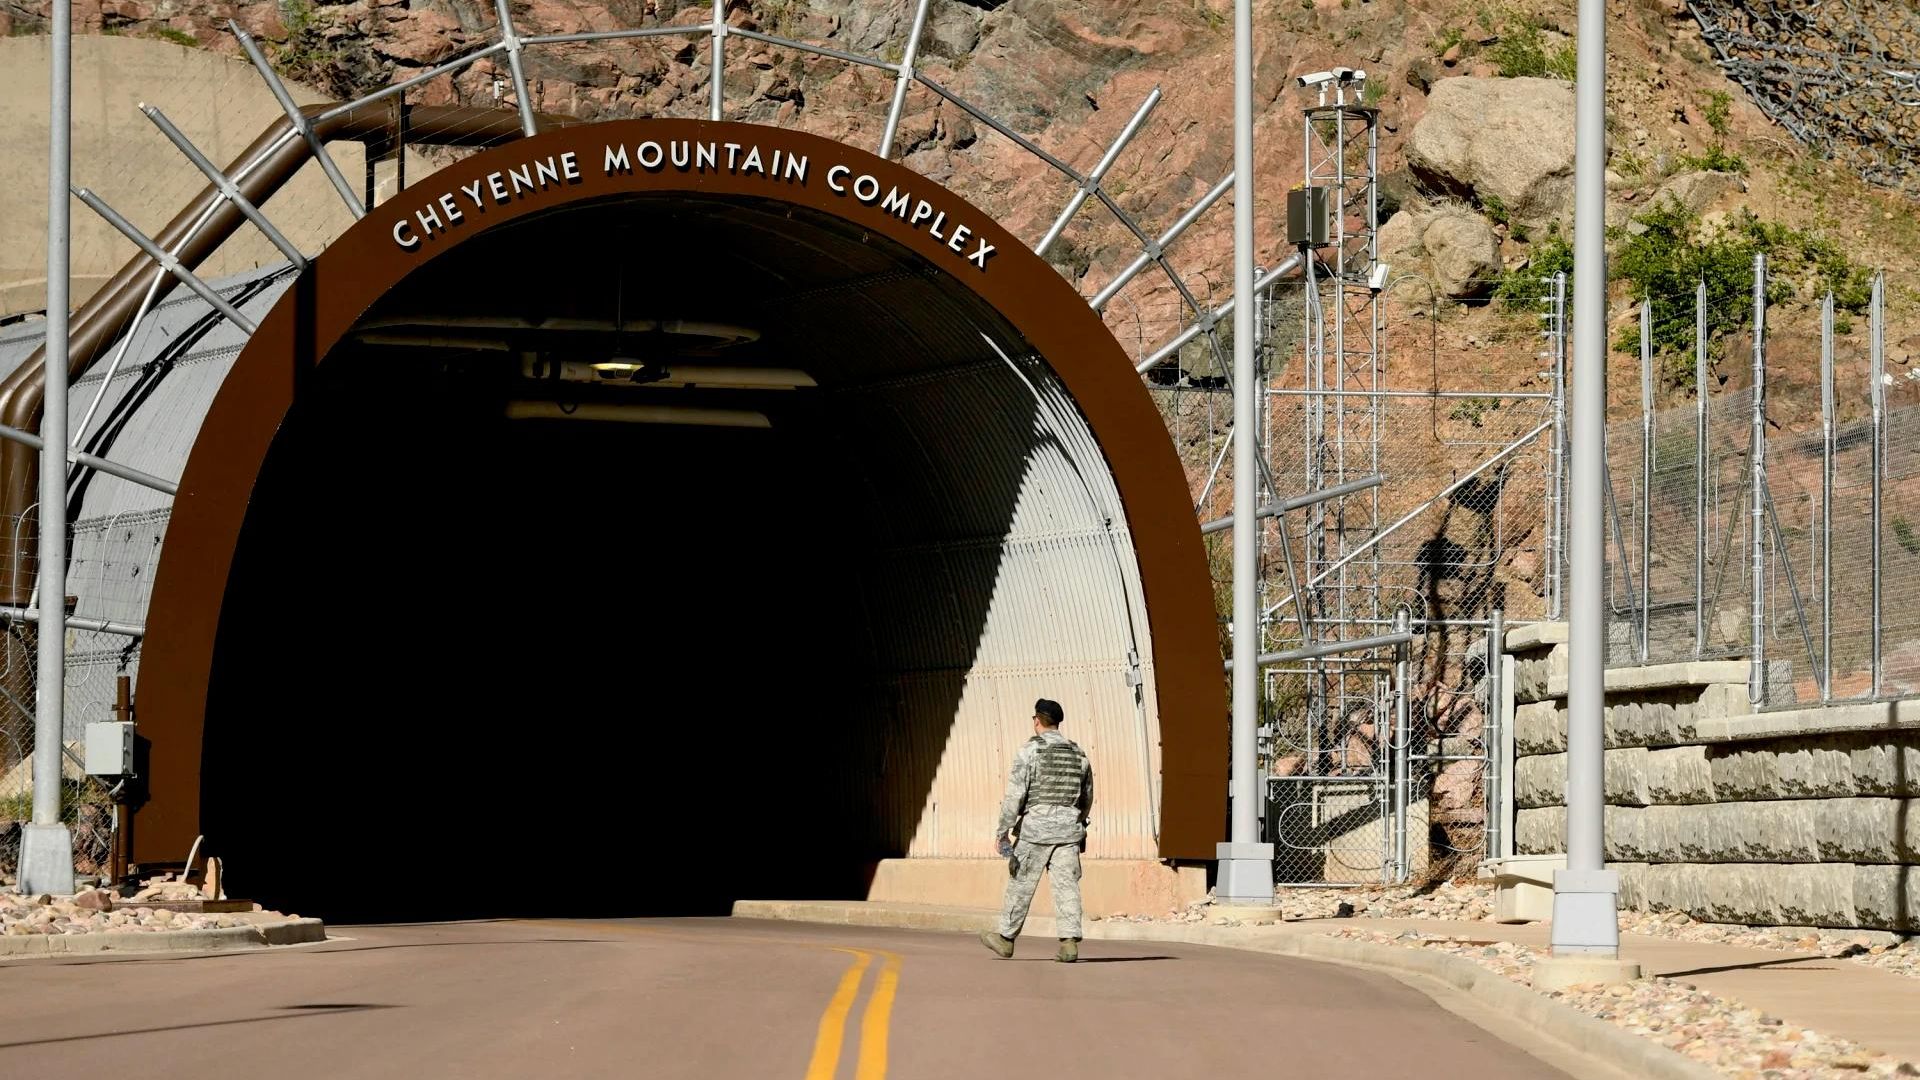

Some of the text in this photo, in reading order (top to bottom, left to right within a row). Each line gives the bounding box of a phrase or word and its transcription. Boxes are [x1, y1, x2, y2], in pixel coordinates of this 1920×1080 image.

[393, 140, 997, 269] CHEYENNE MOUNTAIN COMPLEX
